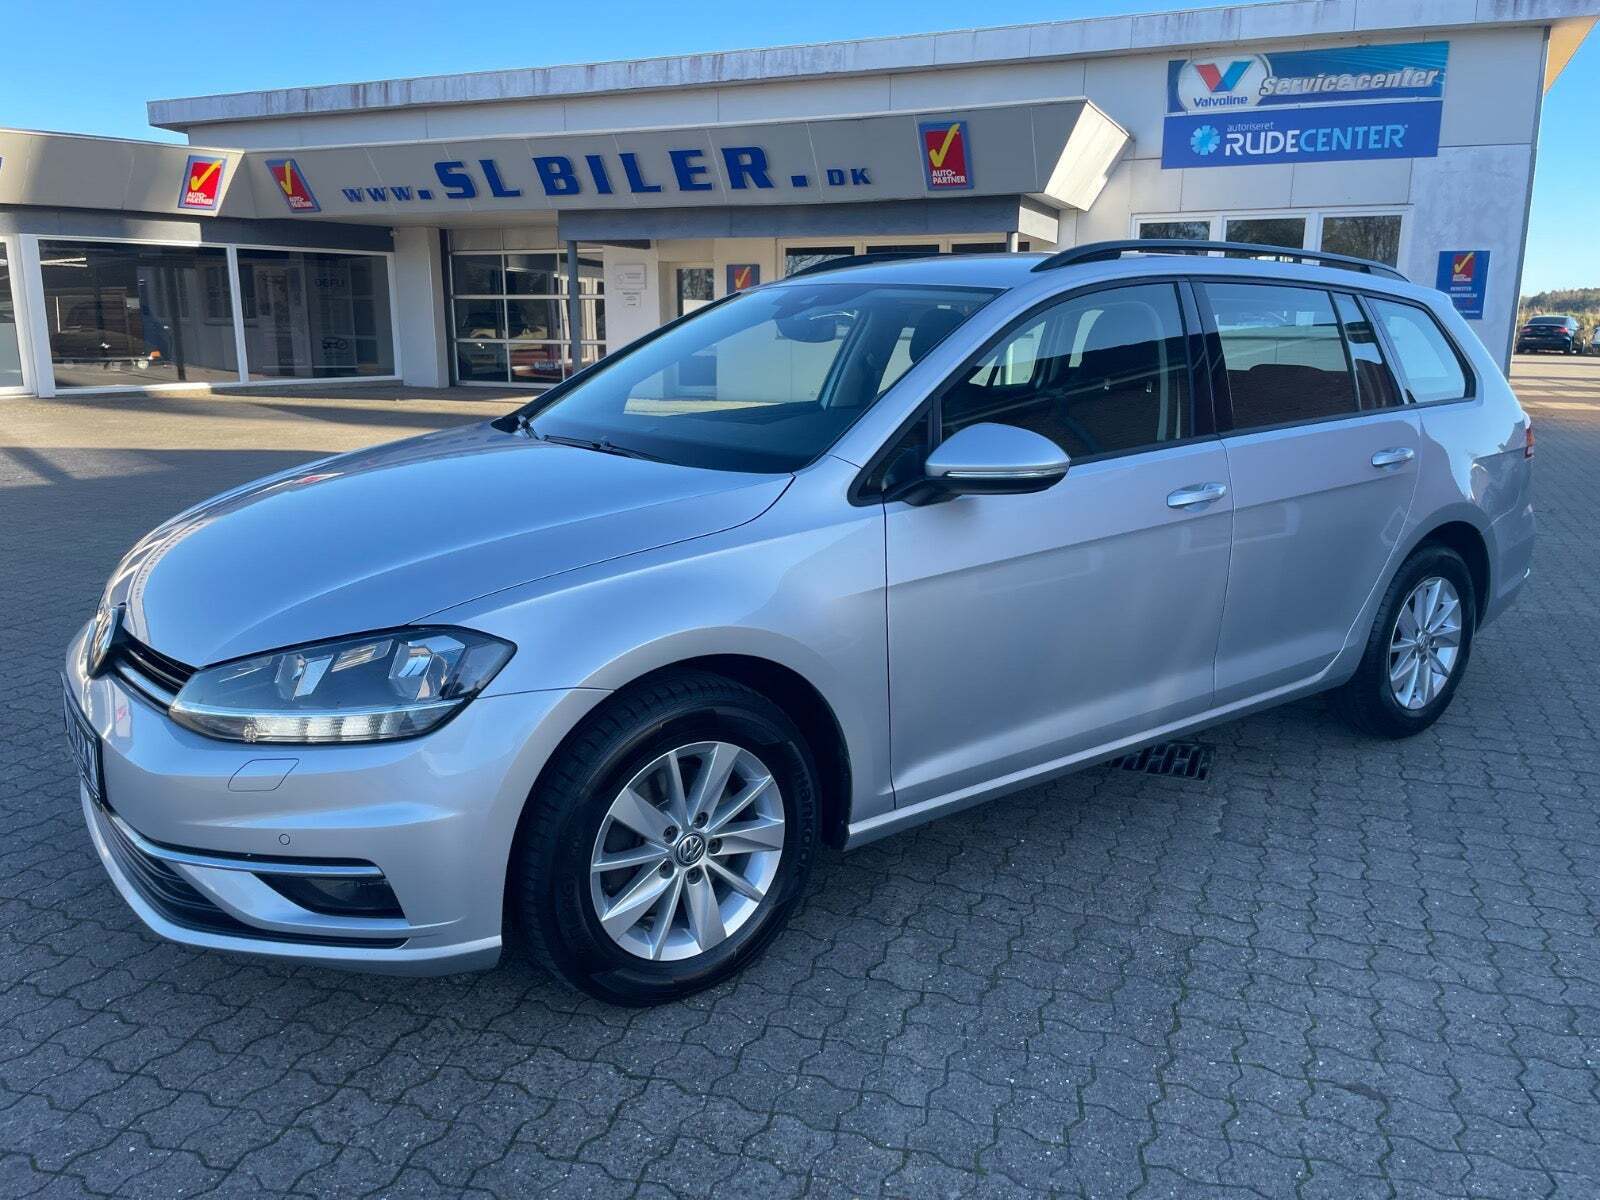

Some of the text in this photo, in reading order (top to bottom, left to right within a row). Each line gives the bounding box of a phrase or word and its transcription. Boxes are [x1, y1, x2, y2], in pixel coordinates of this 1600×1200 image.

[1193, 96, 1249, 107] Valvoline
[1226, 121, 1275, 132] autoriseret
[932, 175, 967, 185] PARTNER
